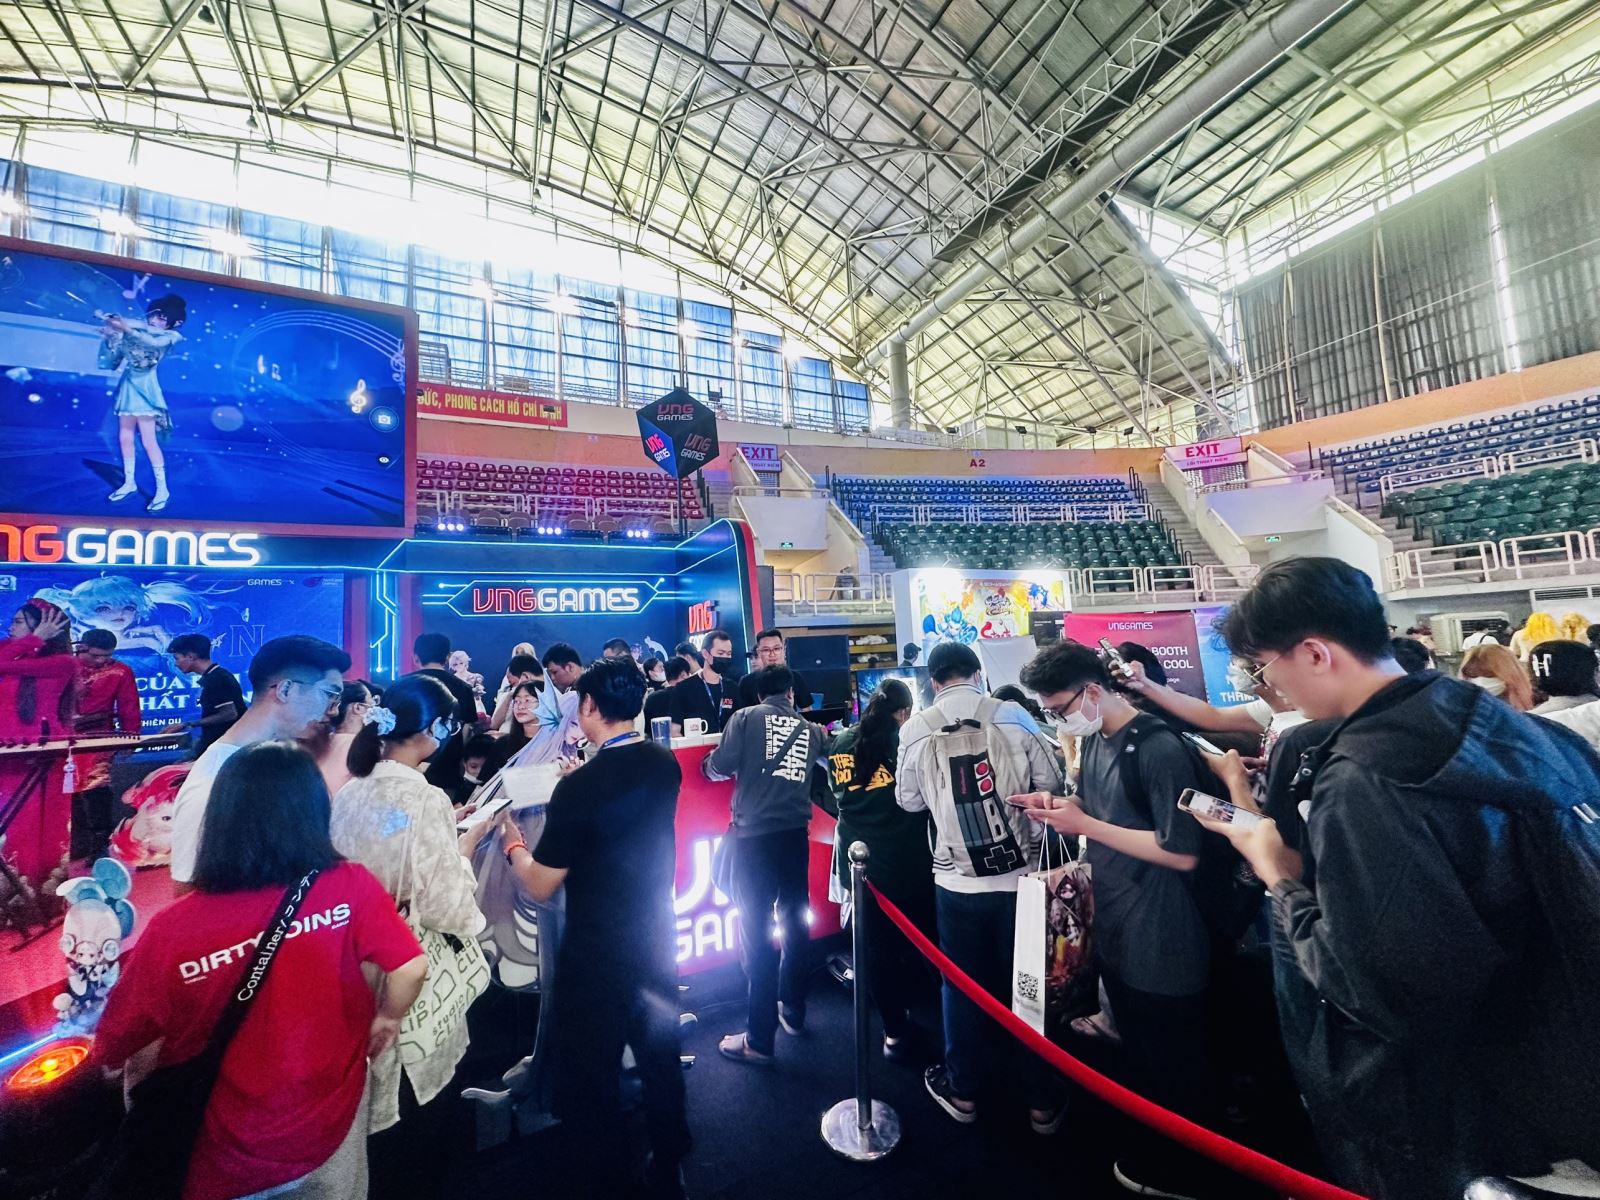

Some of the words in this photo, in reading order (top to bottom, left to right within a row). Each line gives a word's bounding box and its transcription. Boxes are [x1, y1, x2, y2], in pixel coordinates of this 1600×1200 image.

[445, 393, 477, 411] PHONG
[480, 395, 505, 414] CÁCH
[657, 413, 693, 421] GAMES
[681, 448, 706, 461] GAMES
[741, 446, 774, 459] EXIT
[1185, 443, 1220, 458] EXIT
[970, 458, 986, 468] A2
[247, 578, 282, 586] GAMES
[1152, 646, 1188, 656] BOOTH
[1163, 659, 1194, 669] COOL
[135, 672, 185, 691] CỦA
[139, 690, 190, 710] HẤT
[142, 718, 166, 727] HIÊN
[179, 930, 265, 979] DIRTY
[285, 903, 350, 939] OINS
